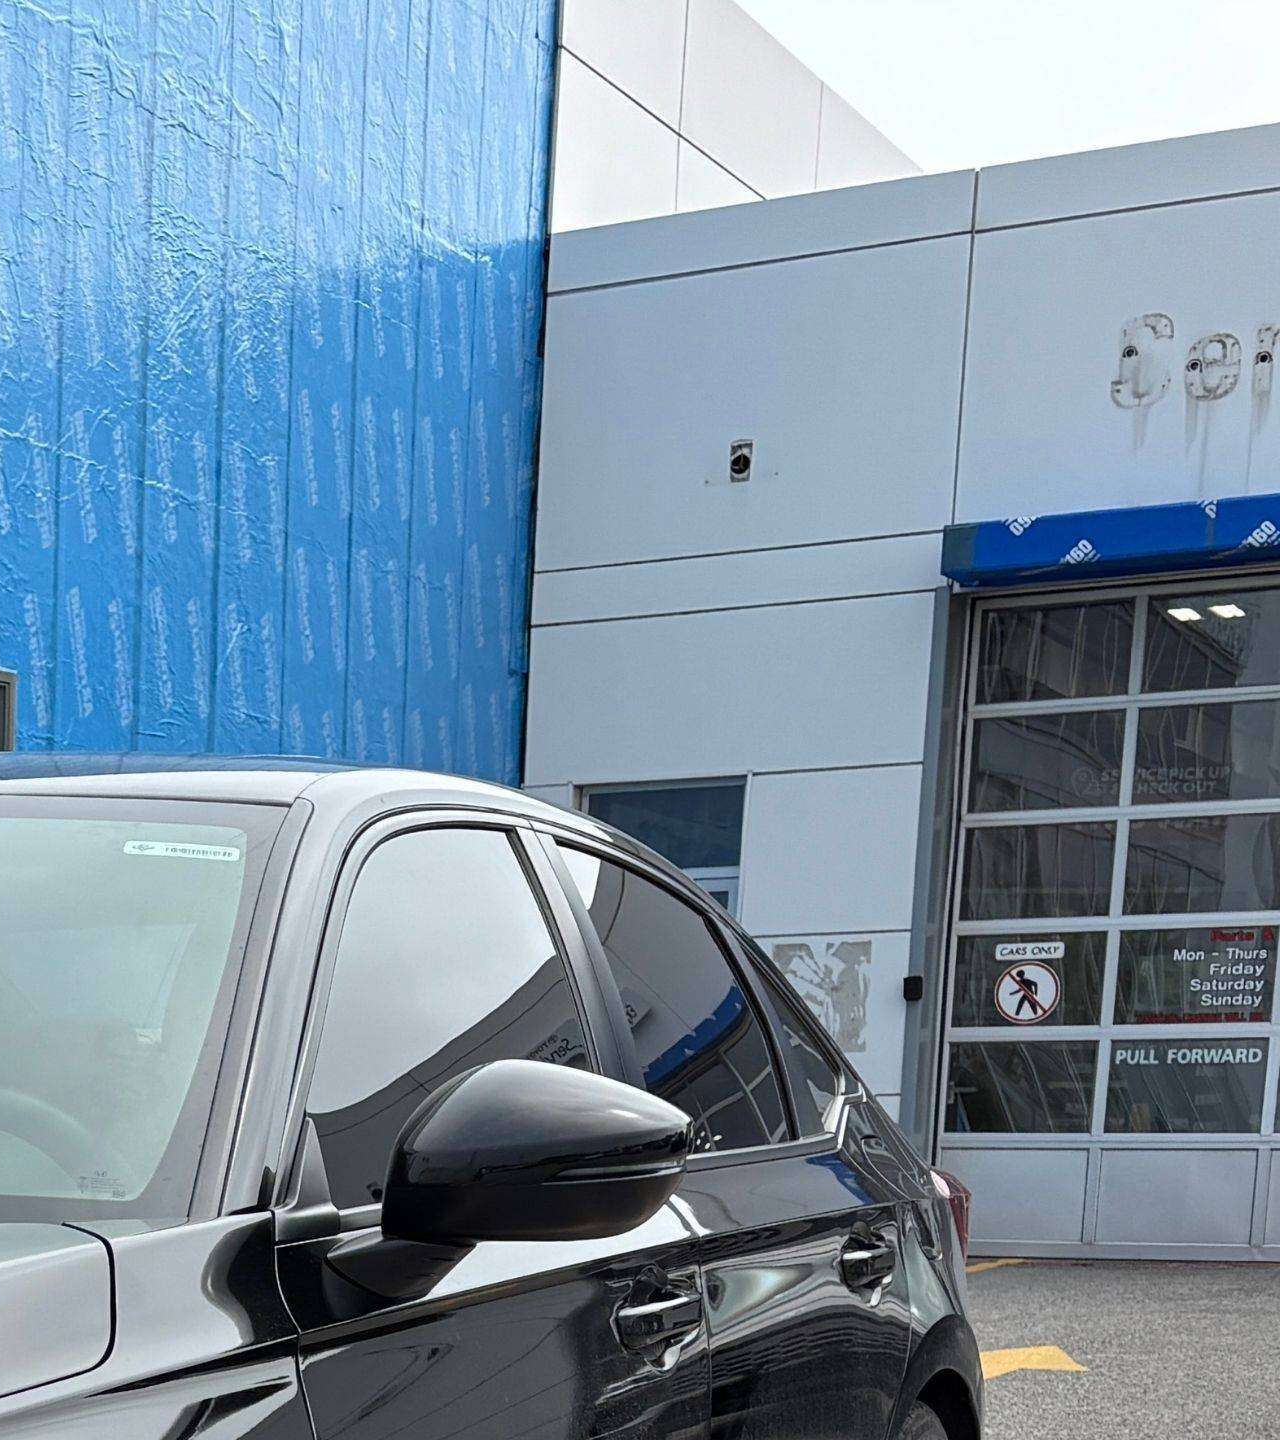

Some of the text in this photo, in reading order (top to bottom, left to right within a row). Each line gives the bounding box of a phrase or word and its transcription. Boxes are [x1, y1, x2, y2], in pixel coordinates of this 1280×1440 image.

[1173, 949, 1204, 961] Mon
[1226, 947, 1268, 959] Thurs
[1209, 963, 1265, 976] Friday
[1190, 978, 1264, 992] Saturday
[1200, 994, 1263, 1007] Sunday
[1115, 1048, 1263, 1064] PULL FORWARD
